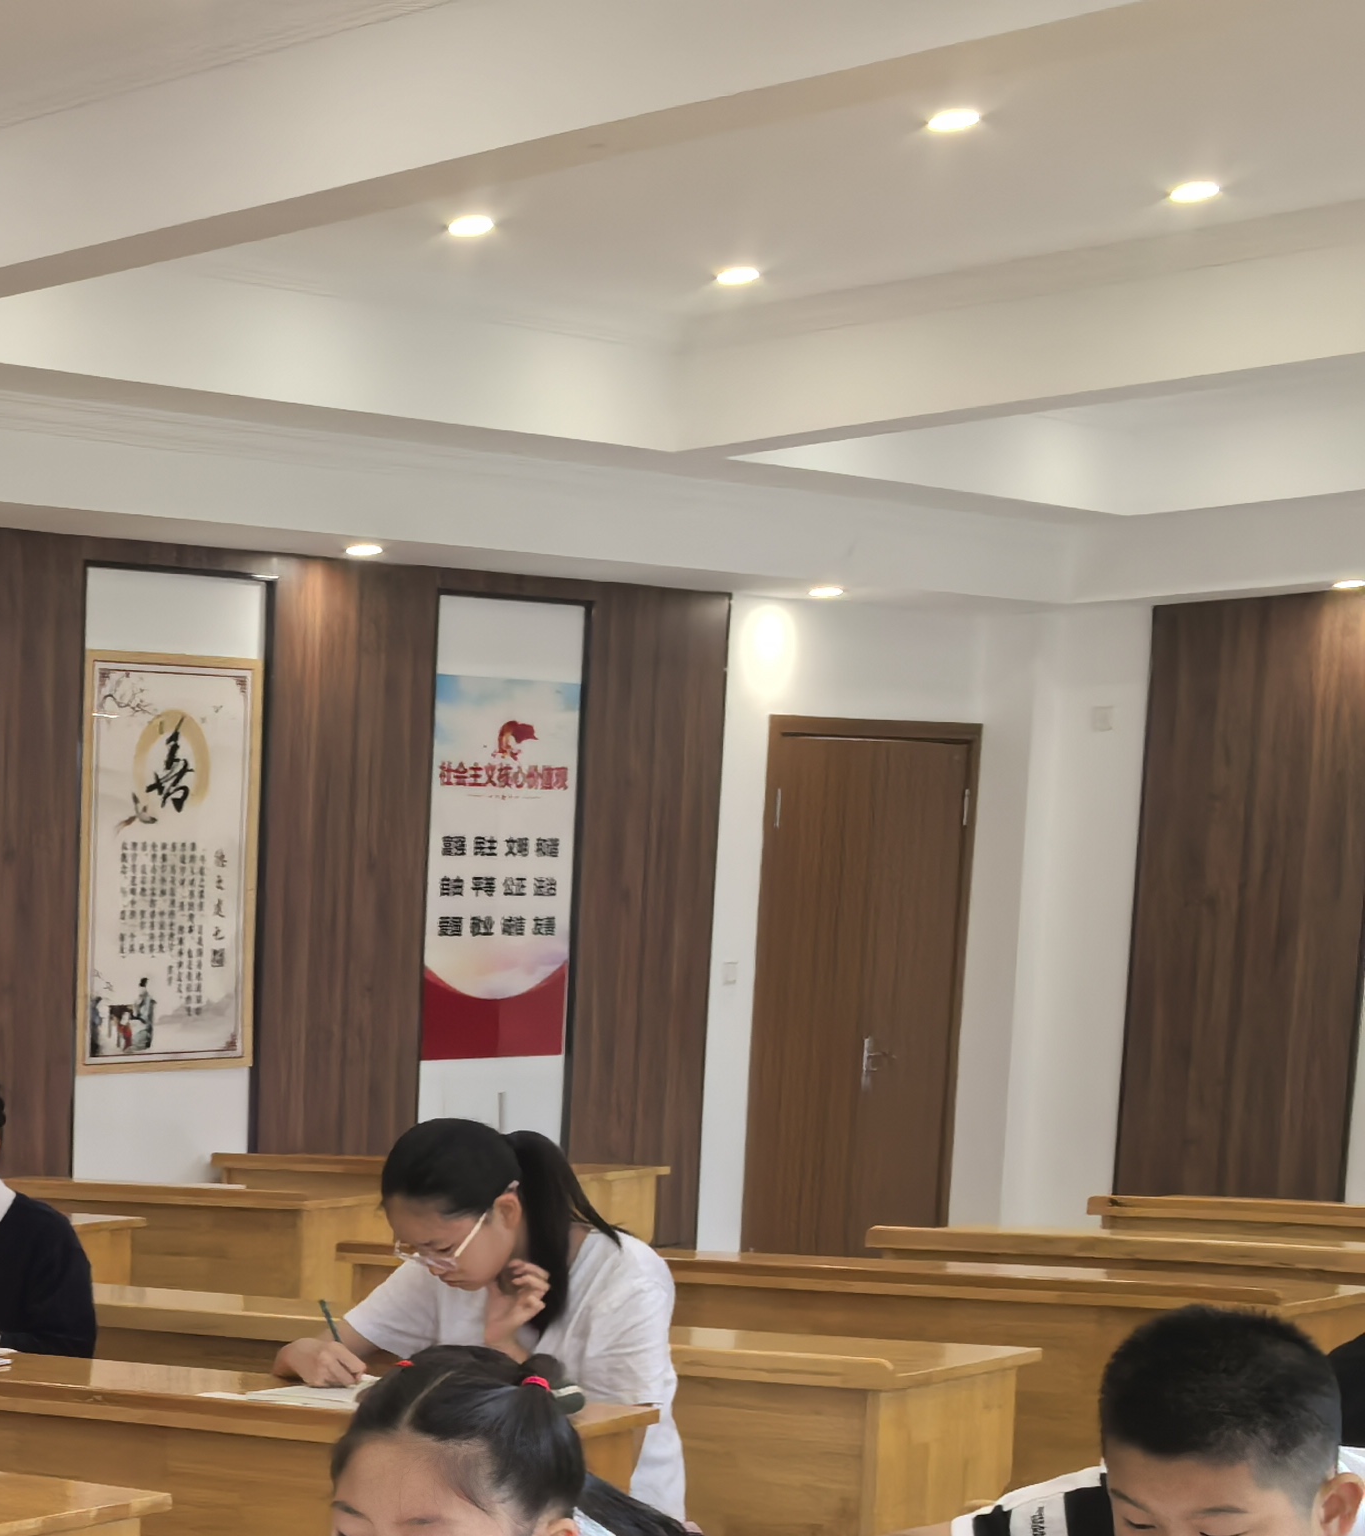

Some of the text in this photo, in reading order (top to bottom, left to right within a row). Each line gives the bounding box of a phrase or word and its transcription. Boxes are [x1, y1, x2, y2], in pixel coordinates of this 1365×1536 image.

[438, 762, 568, 790] 社会主义核心价值观
[505, 837, 529, 857] 文明
